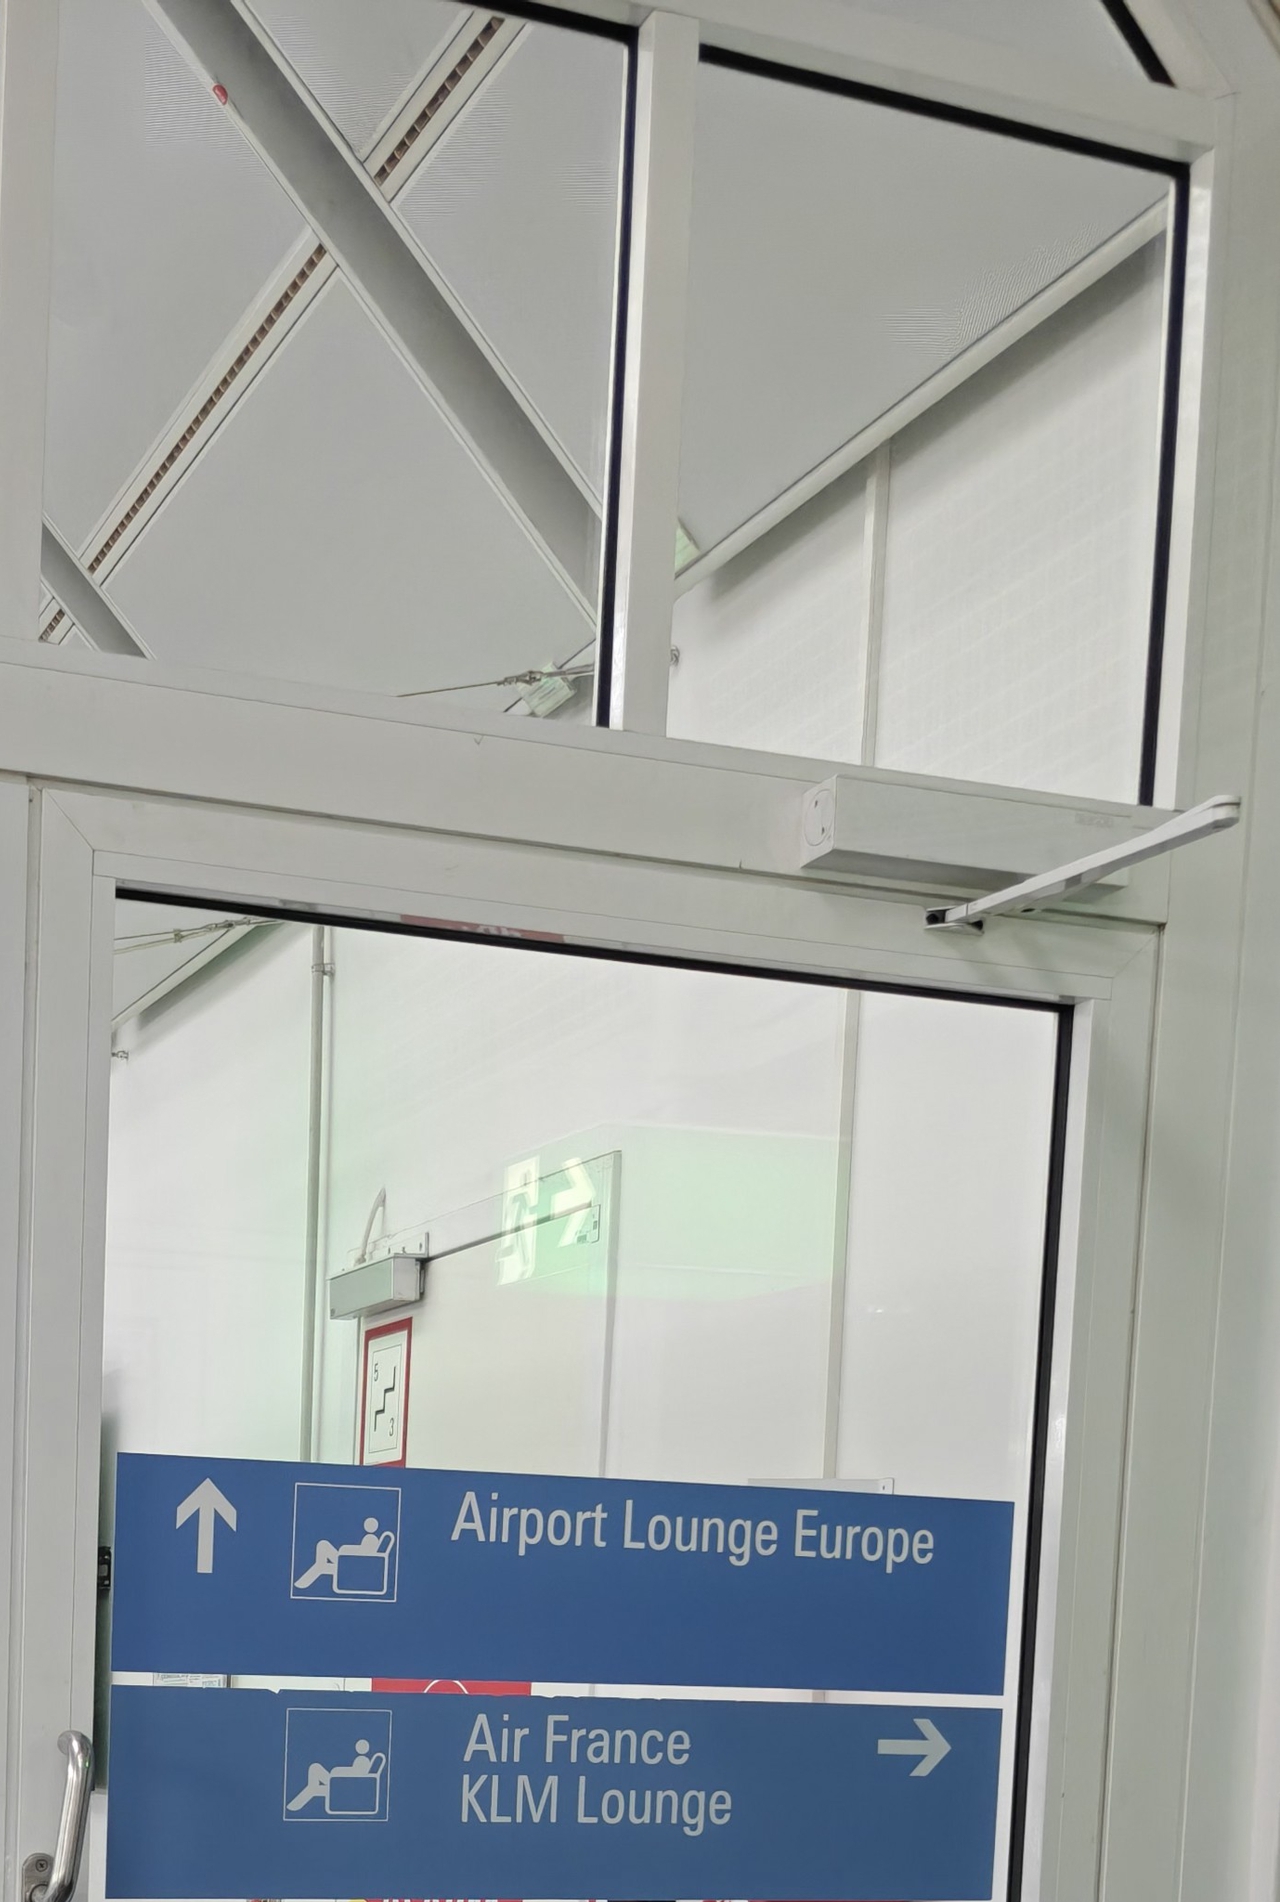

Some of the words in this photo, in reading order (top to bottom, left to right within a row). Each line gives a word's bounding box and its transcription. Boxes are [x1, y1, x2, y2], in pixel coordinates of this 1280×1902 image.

[373, 1363, 379, 1382] 5
[389, 1418, 395, 1437] 3
[451, 1492, 607, 1556] Airport
[624, 1500, 777, 1566] Lounge
[795, 1509, 933, 1573] Europe
[464, 1714, 529, 1762] Air
[546, 1715, 691, 1764] France
[462, 1774, 558, 1823] KLM
[578, 1776, 731, 1836] Lounge
